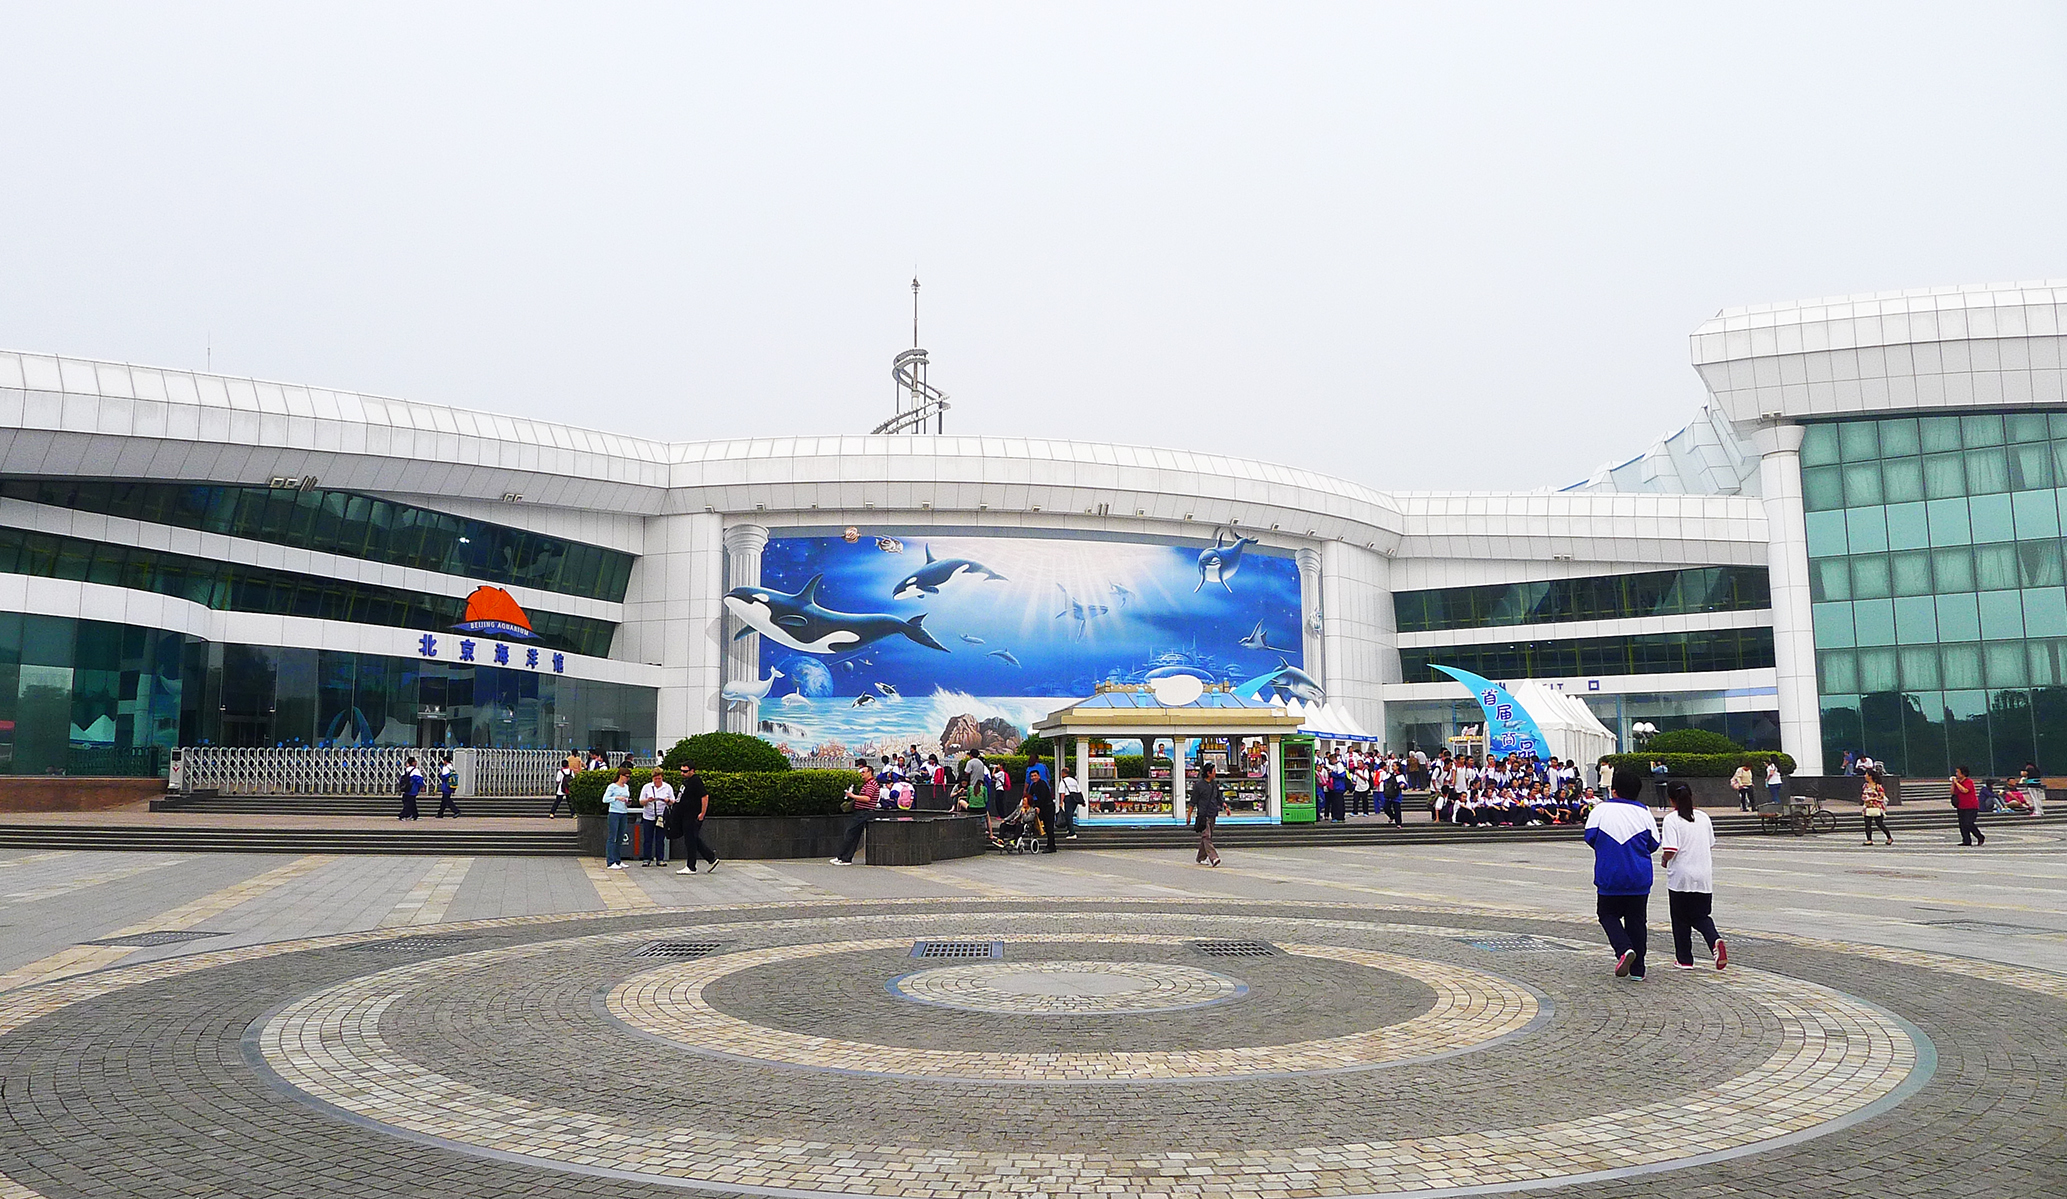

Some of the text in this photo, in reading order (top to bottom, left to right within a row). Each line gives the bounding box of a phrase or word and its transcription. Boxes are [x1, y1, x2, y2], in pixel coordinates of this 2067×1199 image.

[470, 621, 529, 636] BEIJING AQUARIUM
[418, 634, 564, 673] 北京海洋馆
